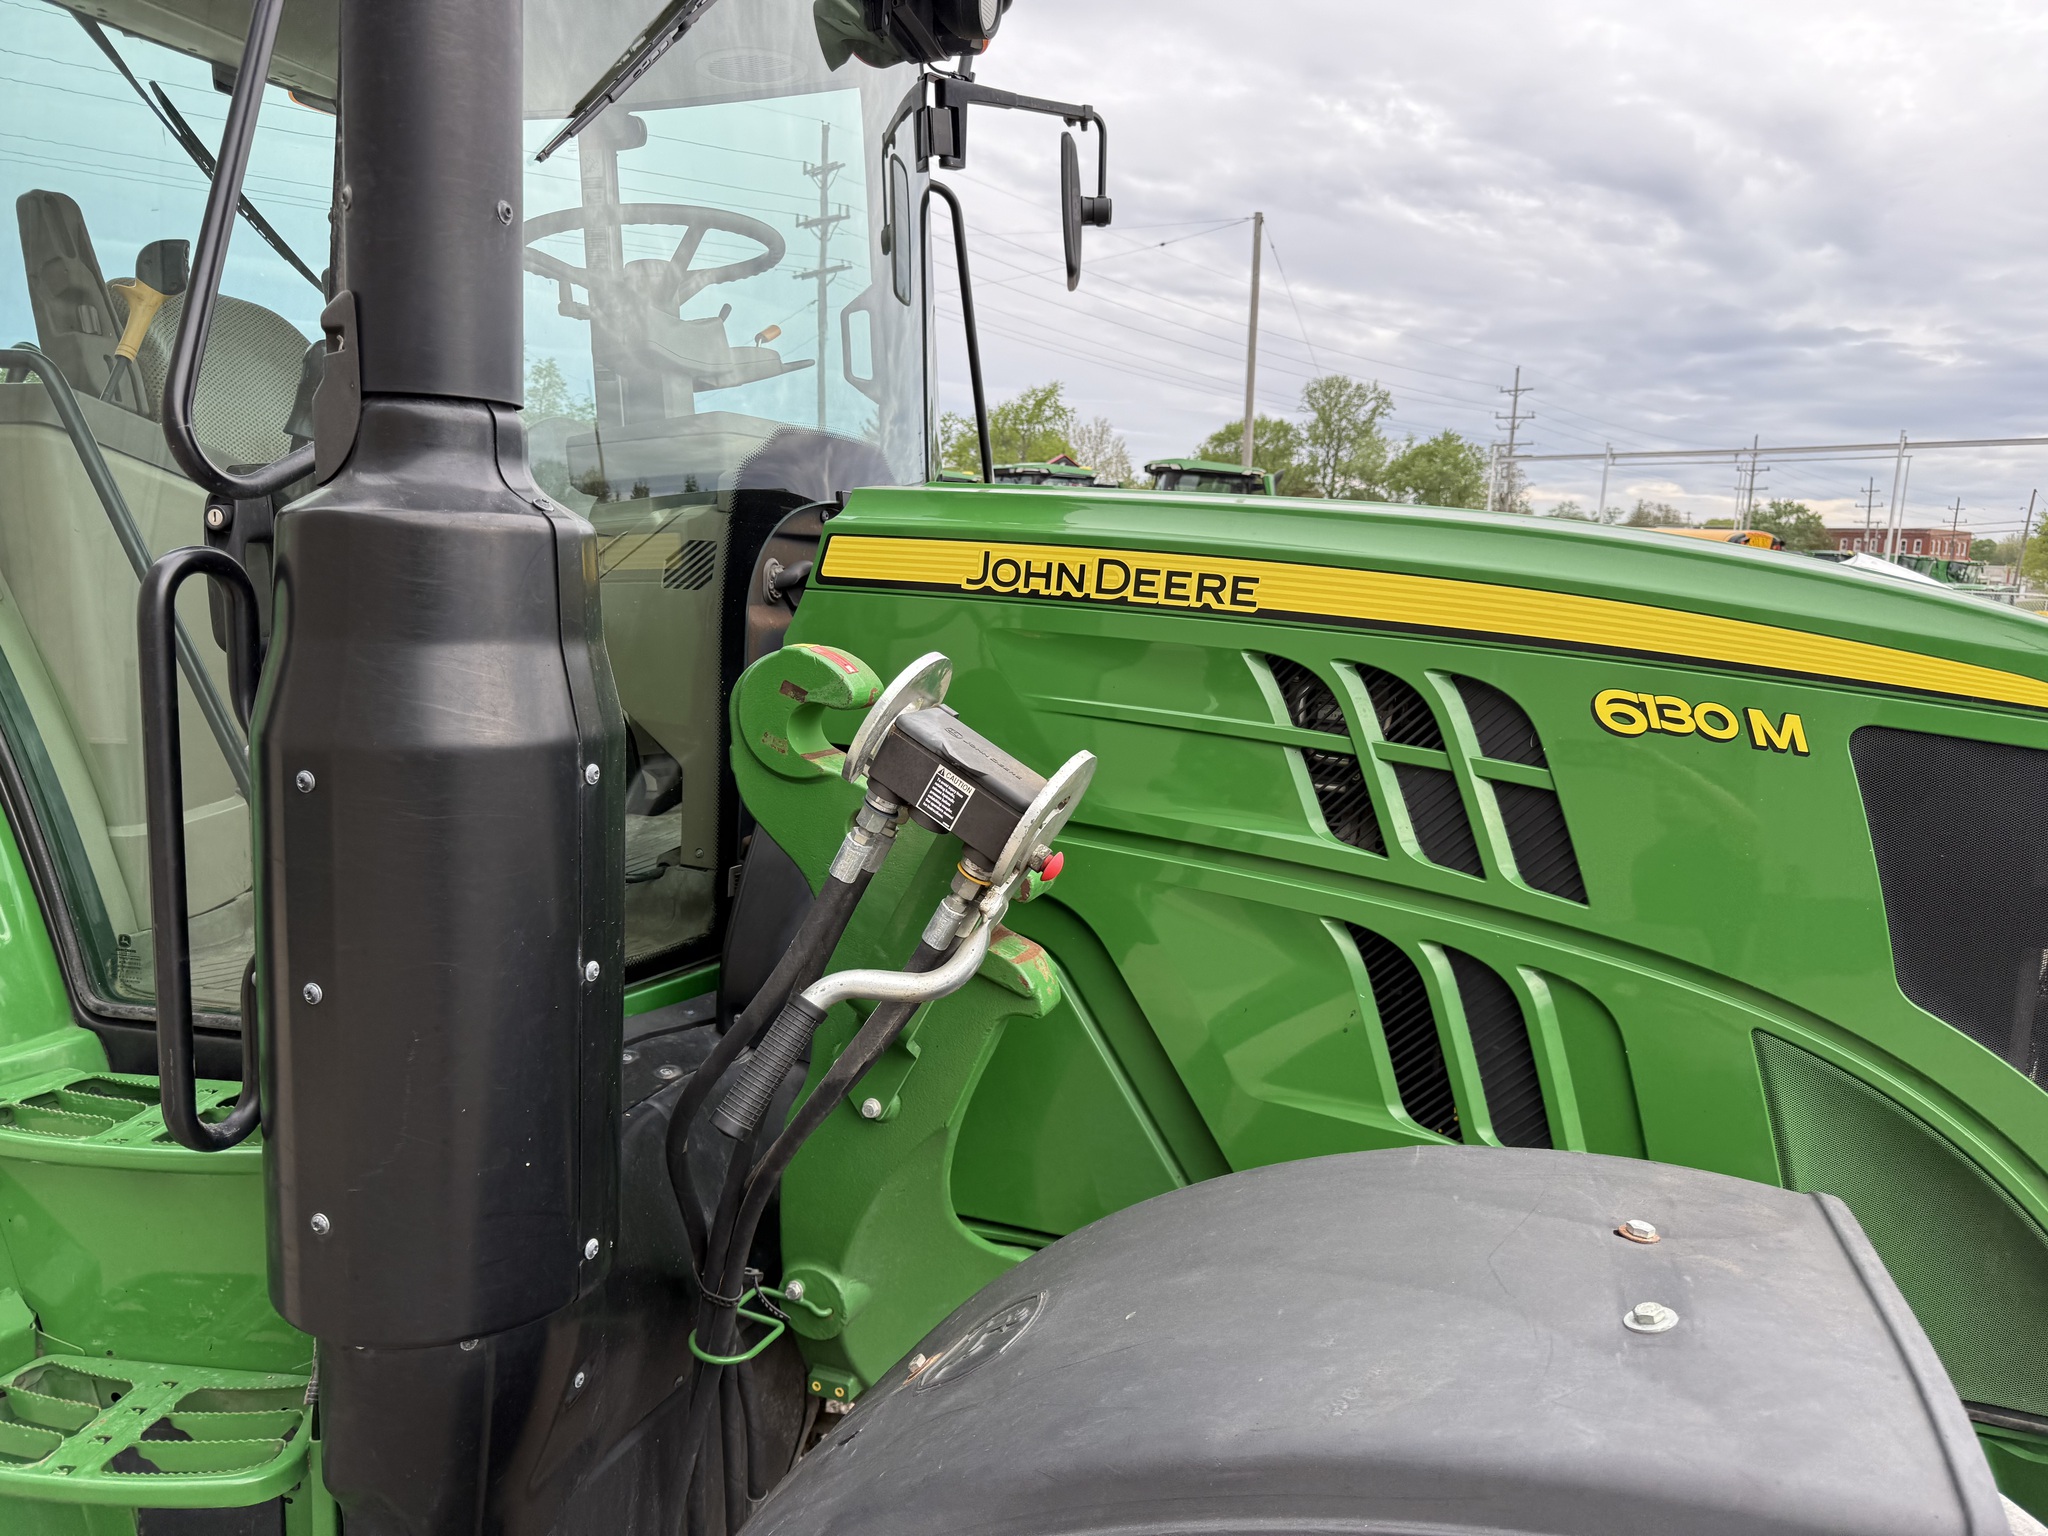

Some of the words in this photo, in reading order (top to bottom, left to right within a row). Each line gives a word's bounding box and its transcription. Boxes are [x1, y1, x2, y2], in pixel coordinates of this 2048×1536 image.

[965, 550, 1087, 594] JOHN
[1094, 557, 1261, 608] DEERE
[1590, 688, 1740, 743] 6130
[1742, 707, 1811, 757] M
[945, 772, 973, 794] CAUTION
